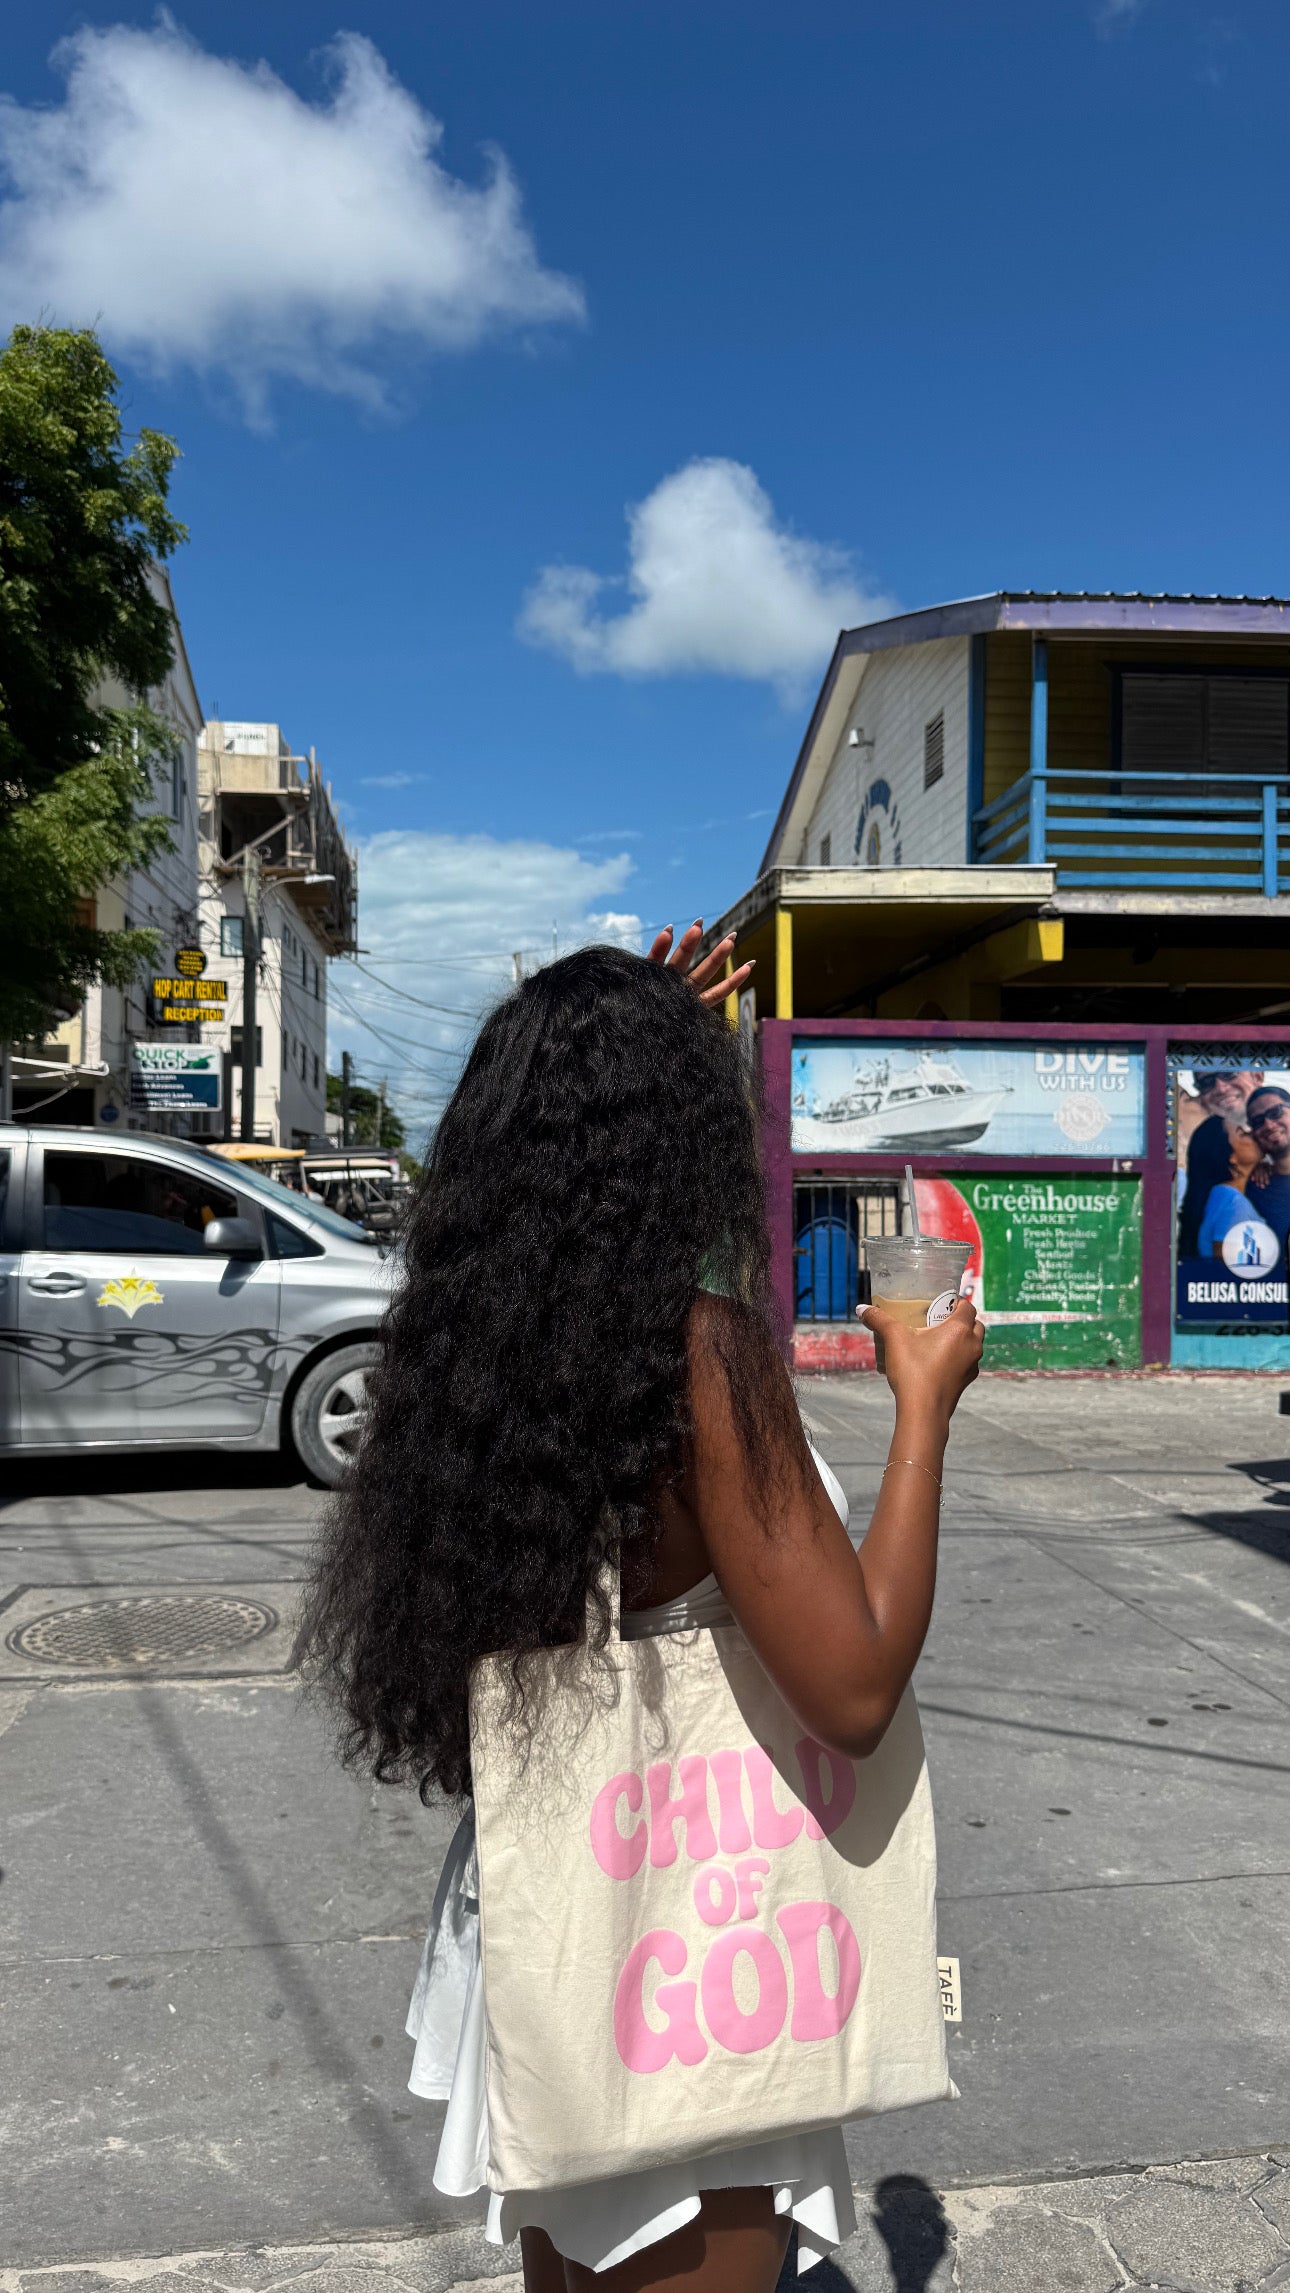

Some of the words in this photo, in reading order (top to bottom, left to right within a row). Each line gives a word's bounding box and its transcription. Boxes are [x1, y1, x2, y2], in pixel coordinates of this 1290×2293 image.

[173, 980, 194, 999] CART
[164, 1007, 223, 1021] RECEPTION
[132, 1047, 185, 1060] QUICK
[1034, 1047, 1130, 1074] DIVE
[1039, 1076, 1096, 1092] WITH
[1101, 1076, 1126, 1092] US
[973, 1184, 1119, 1212] Greenhouse
[1012, 1213, 1078, 1225] MARKET
[1188, 1282, 1236, 1303] BELUSA
[1239, 1282, 1288, 1303] CONSUL
[589, 1734, 856, 1881] CHILD
[693, 1857, 770, 1927] OF
[613, 1900, 861, 2074] GOD
